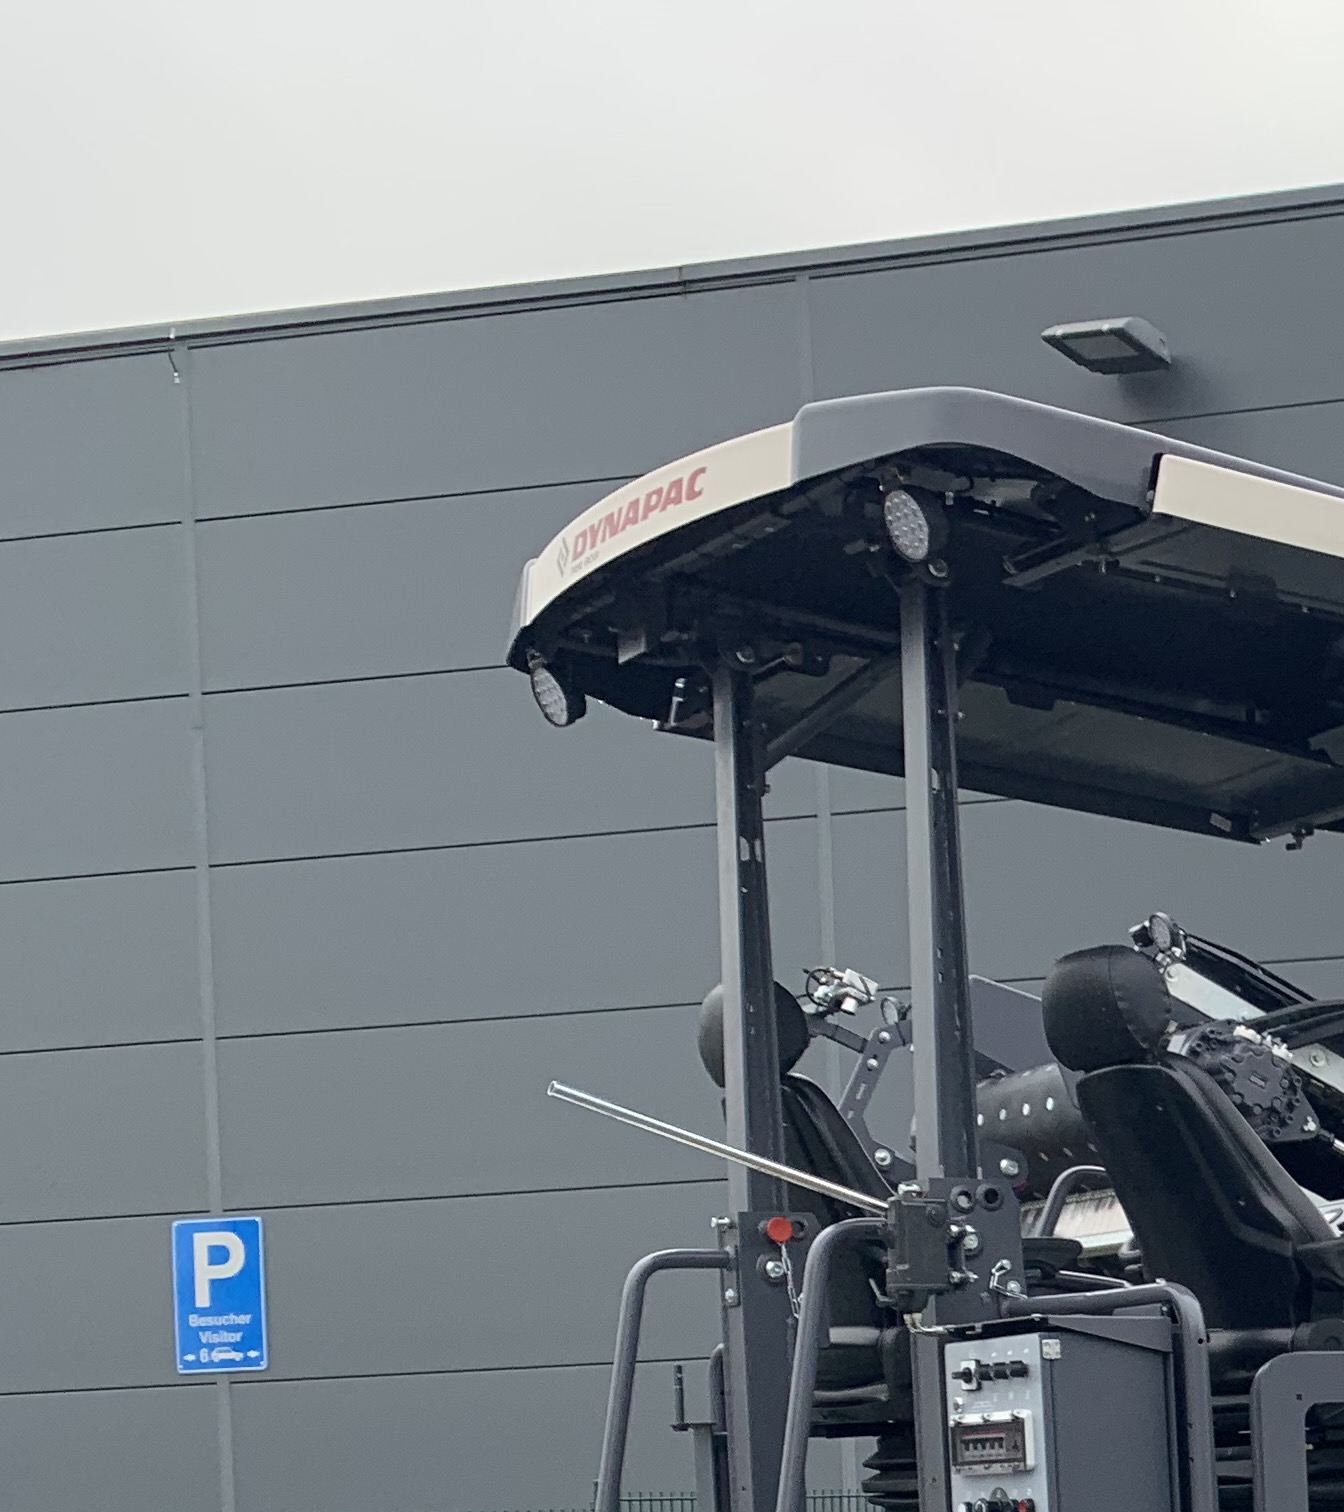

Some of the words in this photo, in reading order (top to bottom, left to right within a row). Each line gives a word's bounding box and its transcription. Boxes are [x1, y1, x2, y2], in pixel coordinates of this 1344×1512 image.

[571, 466, 708, 563] DYNAPAC
[193, 1231, 245, 1308] P
[188, 1313, 252, 1327] Besucher
[199, 1331, 243, 1344] Visitor
